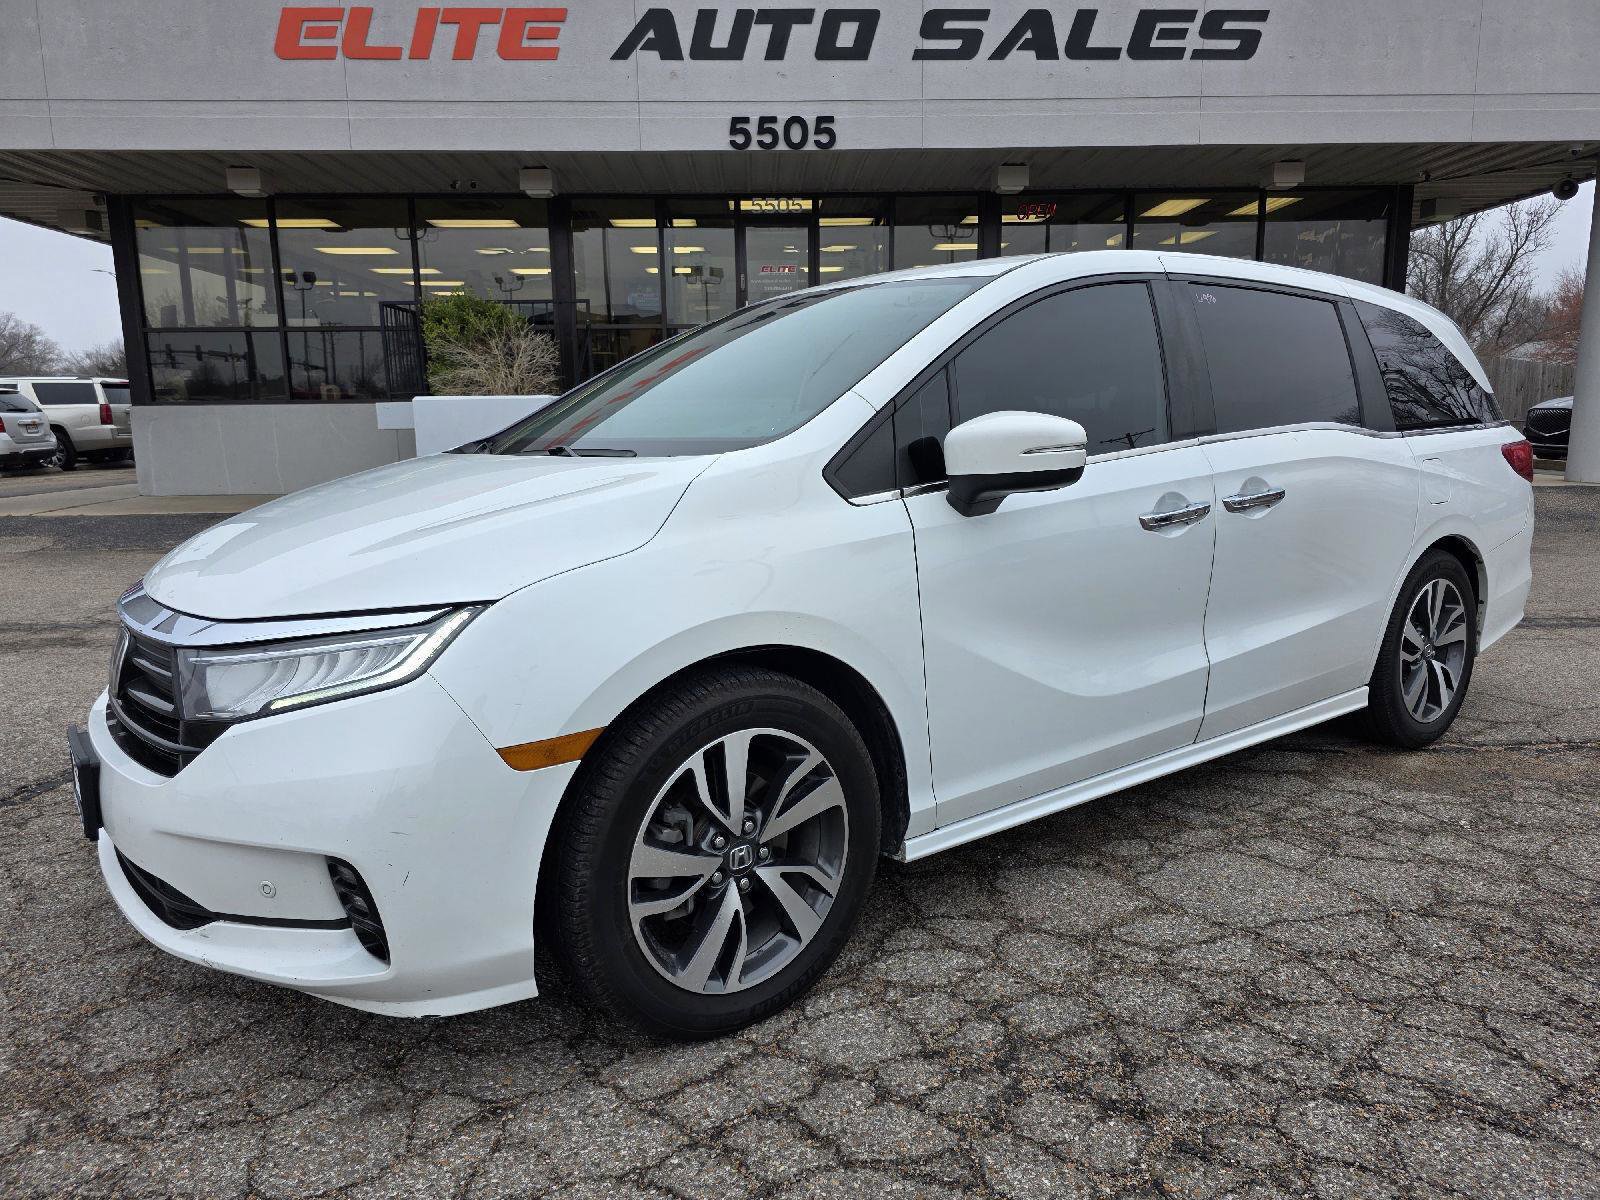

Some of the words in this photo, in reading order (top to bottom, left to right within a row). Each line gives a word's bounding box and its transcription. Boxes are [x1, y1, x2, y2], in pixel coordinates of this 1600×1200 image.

[274, 7, 567, 61] ELITE
[610, 8, 880, 61] AUTO
[912, 9, 1270, 61] SALES
[729, 115, 837, 150] 5505
[752, 198, 802, 213] 5505
[760, 264, 797, 273] ELITE
